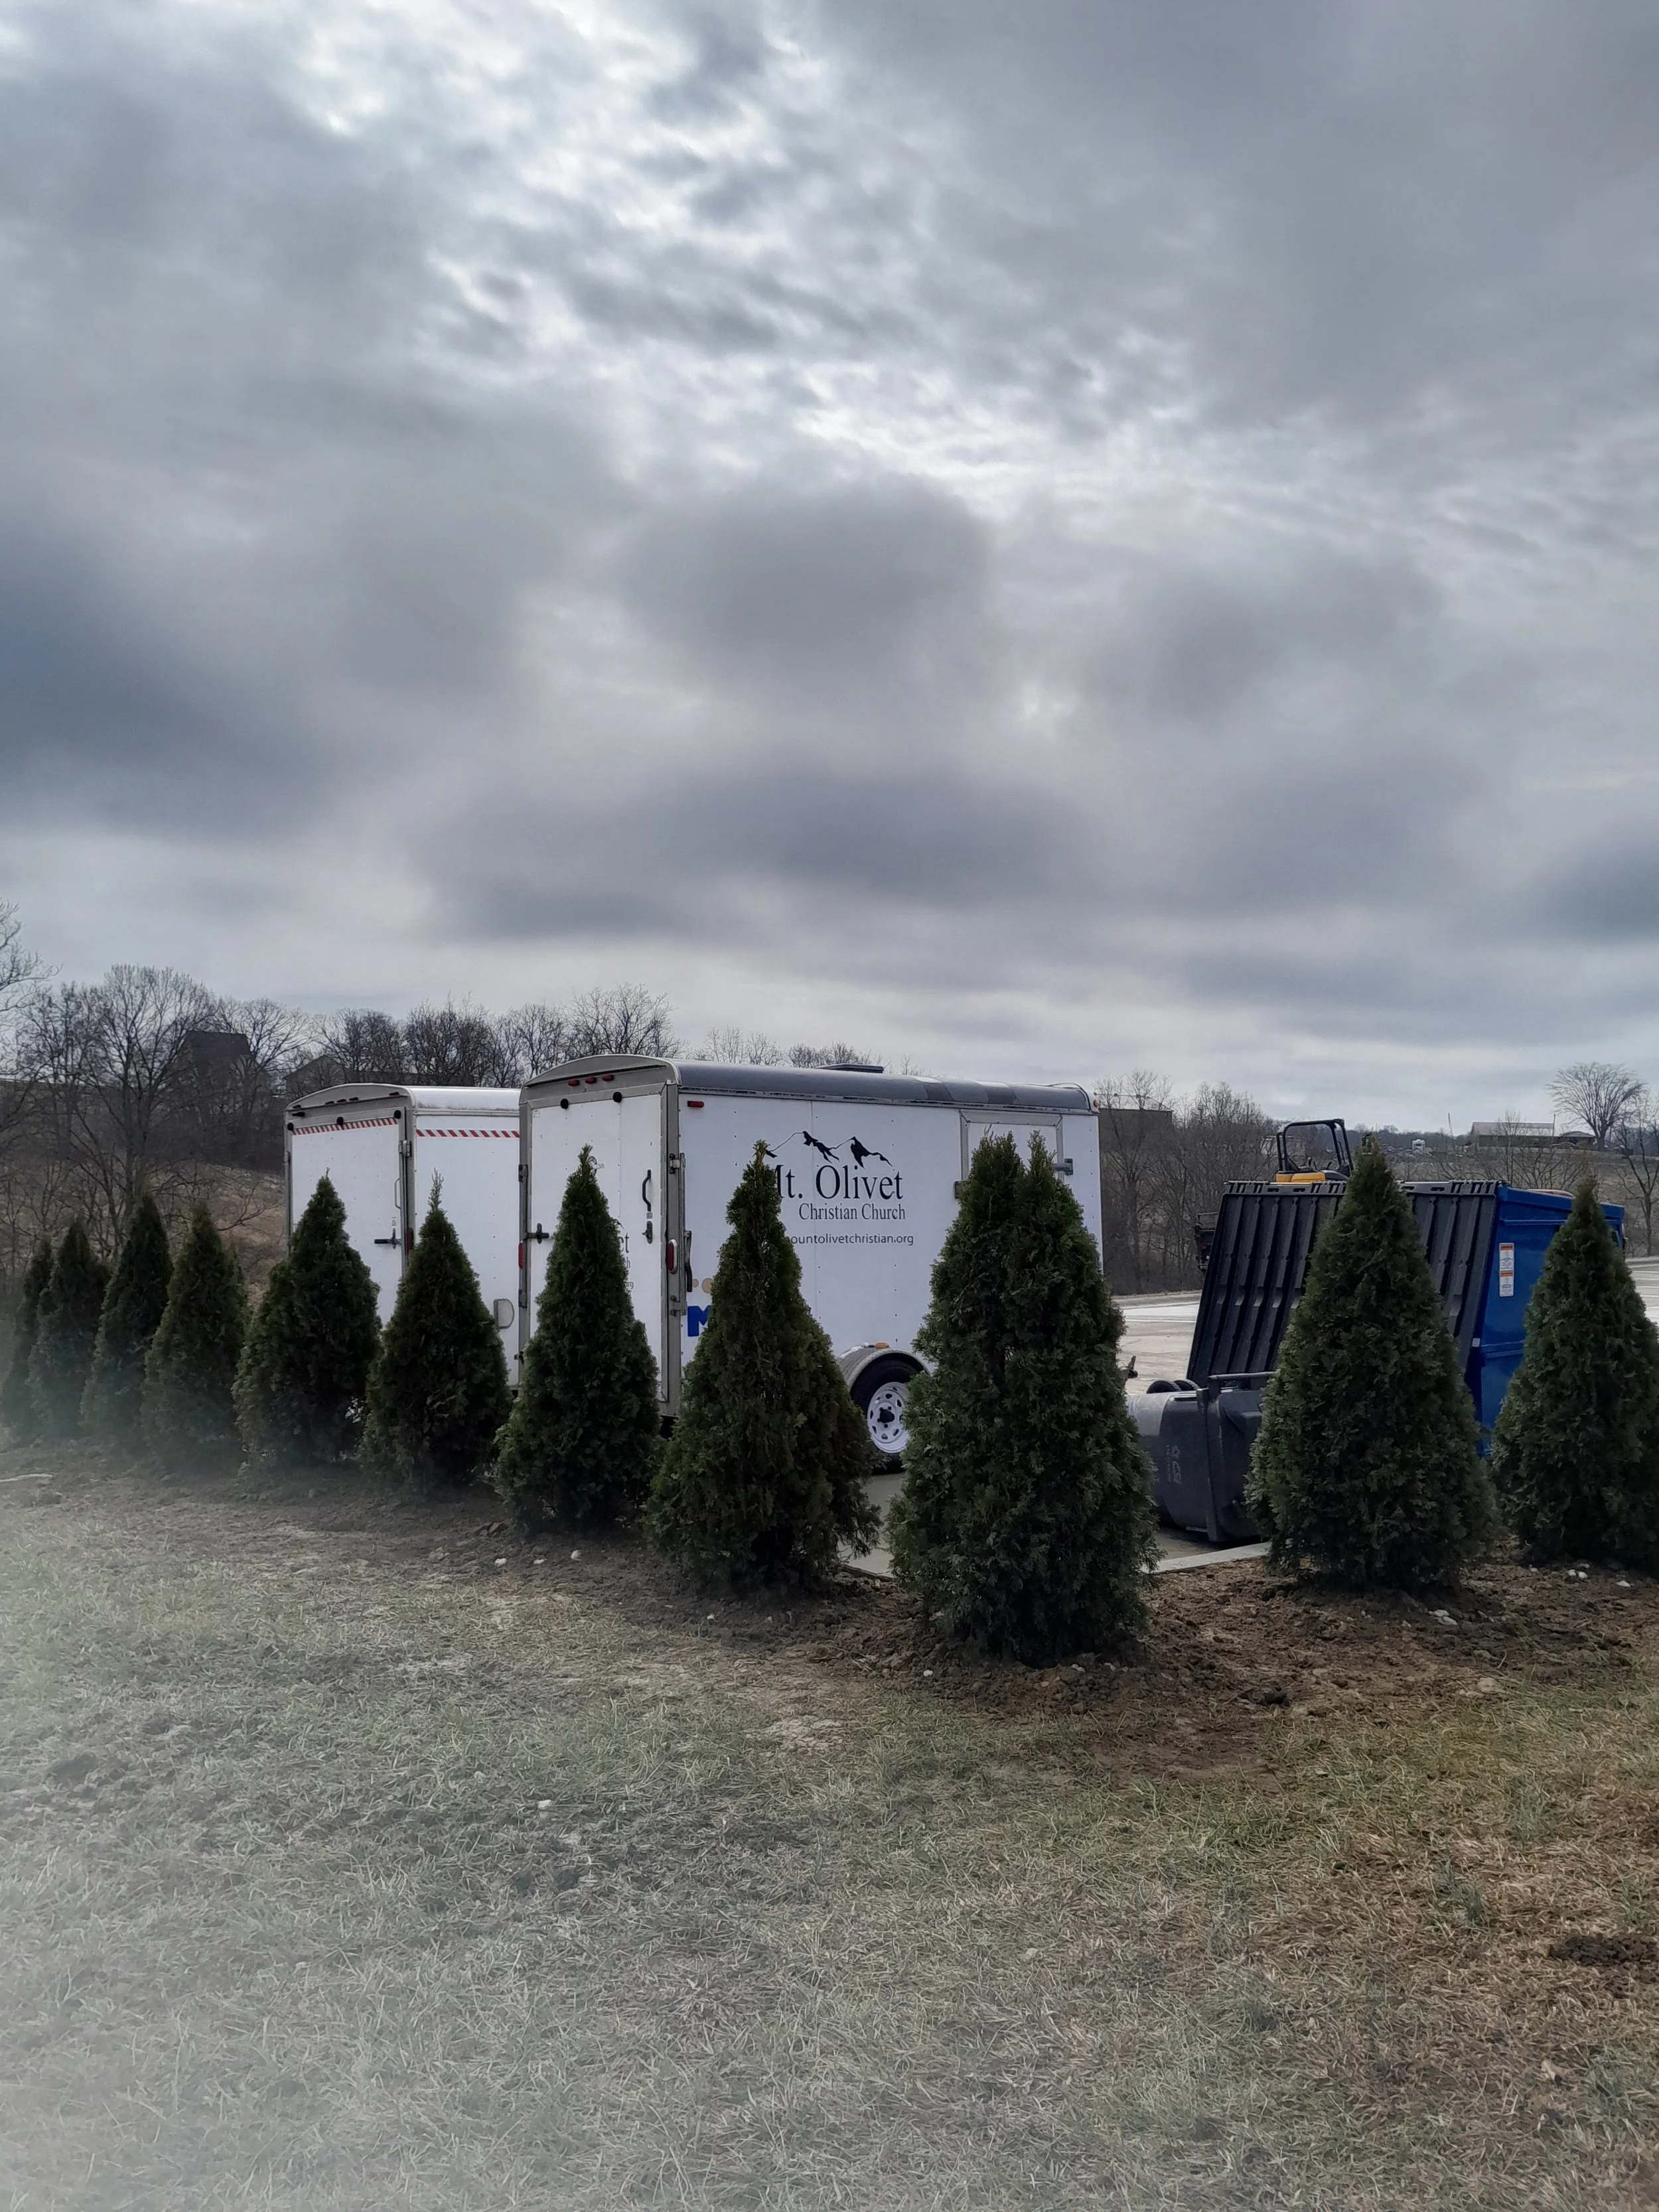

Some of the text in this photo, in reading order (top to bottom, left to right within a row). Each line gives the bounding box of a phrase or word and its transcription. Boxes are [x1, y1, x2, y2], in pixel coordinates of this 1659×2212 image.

[816, 1165, 904, 1200] Olivet
[798, 1203, 906, 1220] Christian Church
[788, 1233, 914, 1246] ountolivetchristian.org
